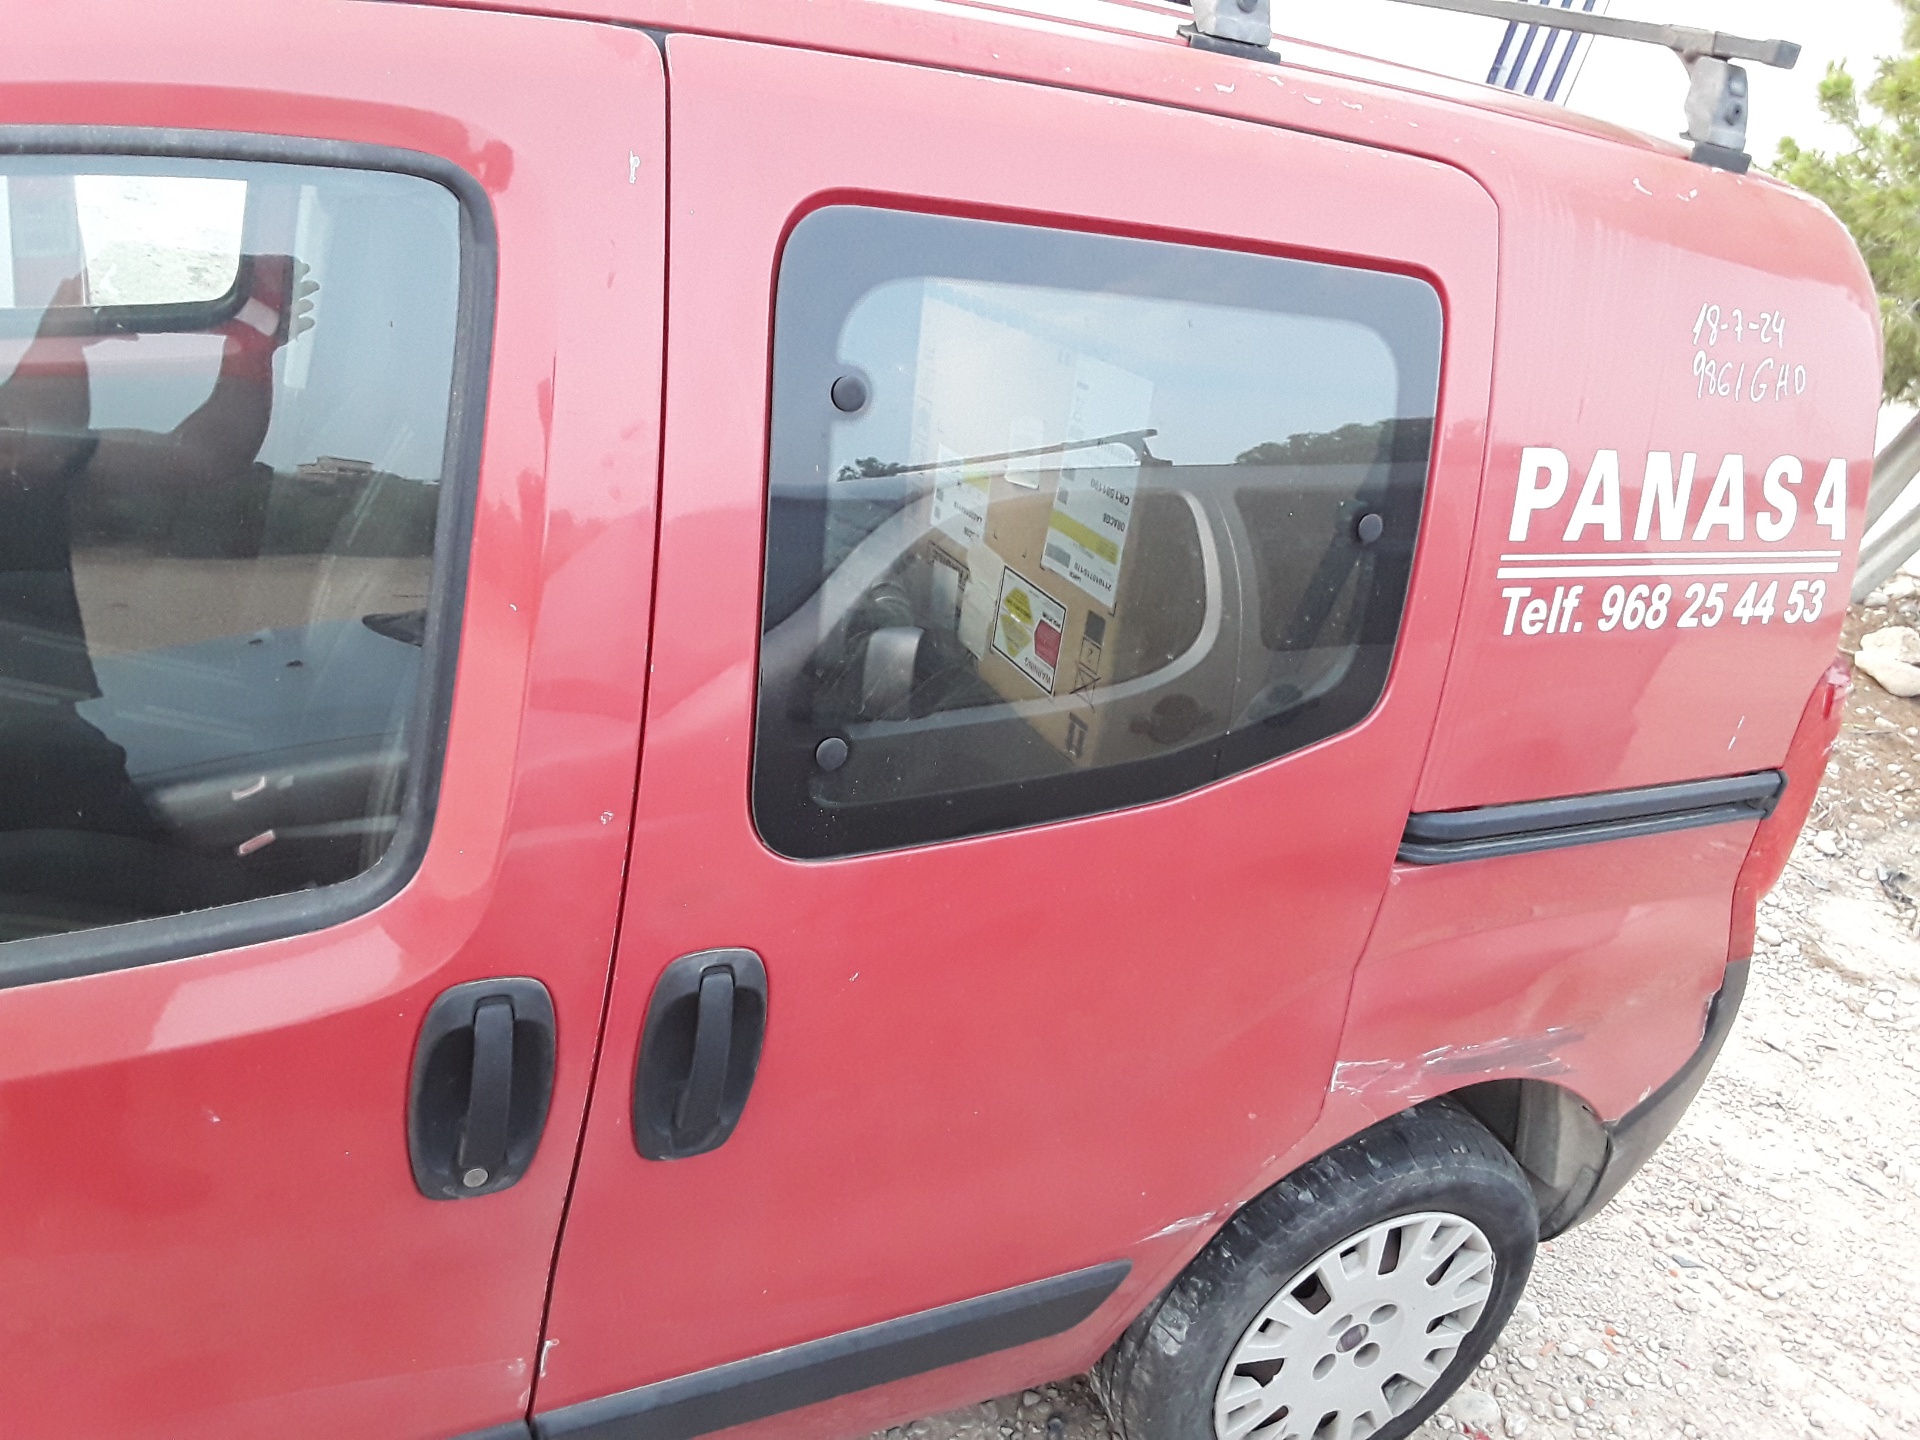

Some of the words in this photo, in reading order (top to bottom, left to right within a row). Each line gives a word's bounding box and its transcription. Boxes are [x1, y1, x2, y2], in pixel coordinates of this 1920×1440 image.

[1692, 302, 1786, 349] 18-7-24
[1502, 585, 1584, 635] Telf.
[1597, 584, 1672, 632] 968
[1677, 582, 1729, 628] 25
[1733, 580, 1778, 625] 44
[1784, 579, 1826, 624] 53
